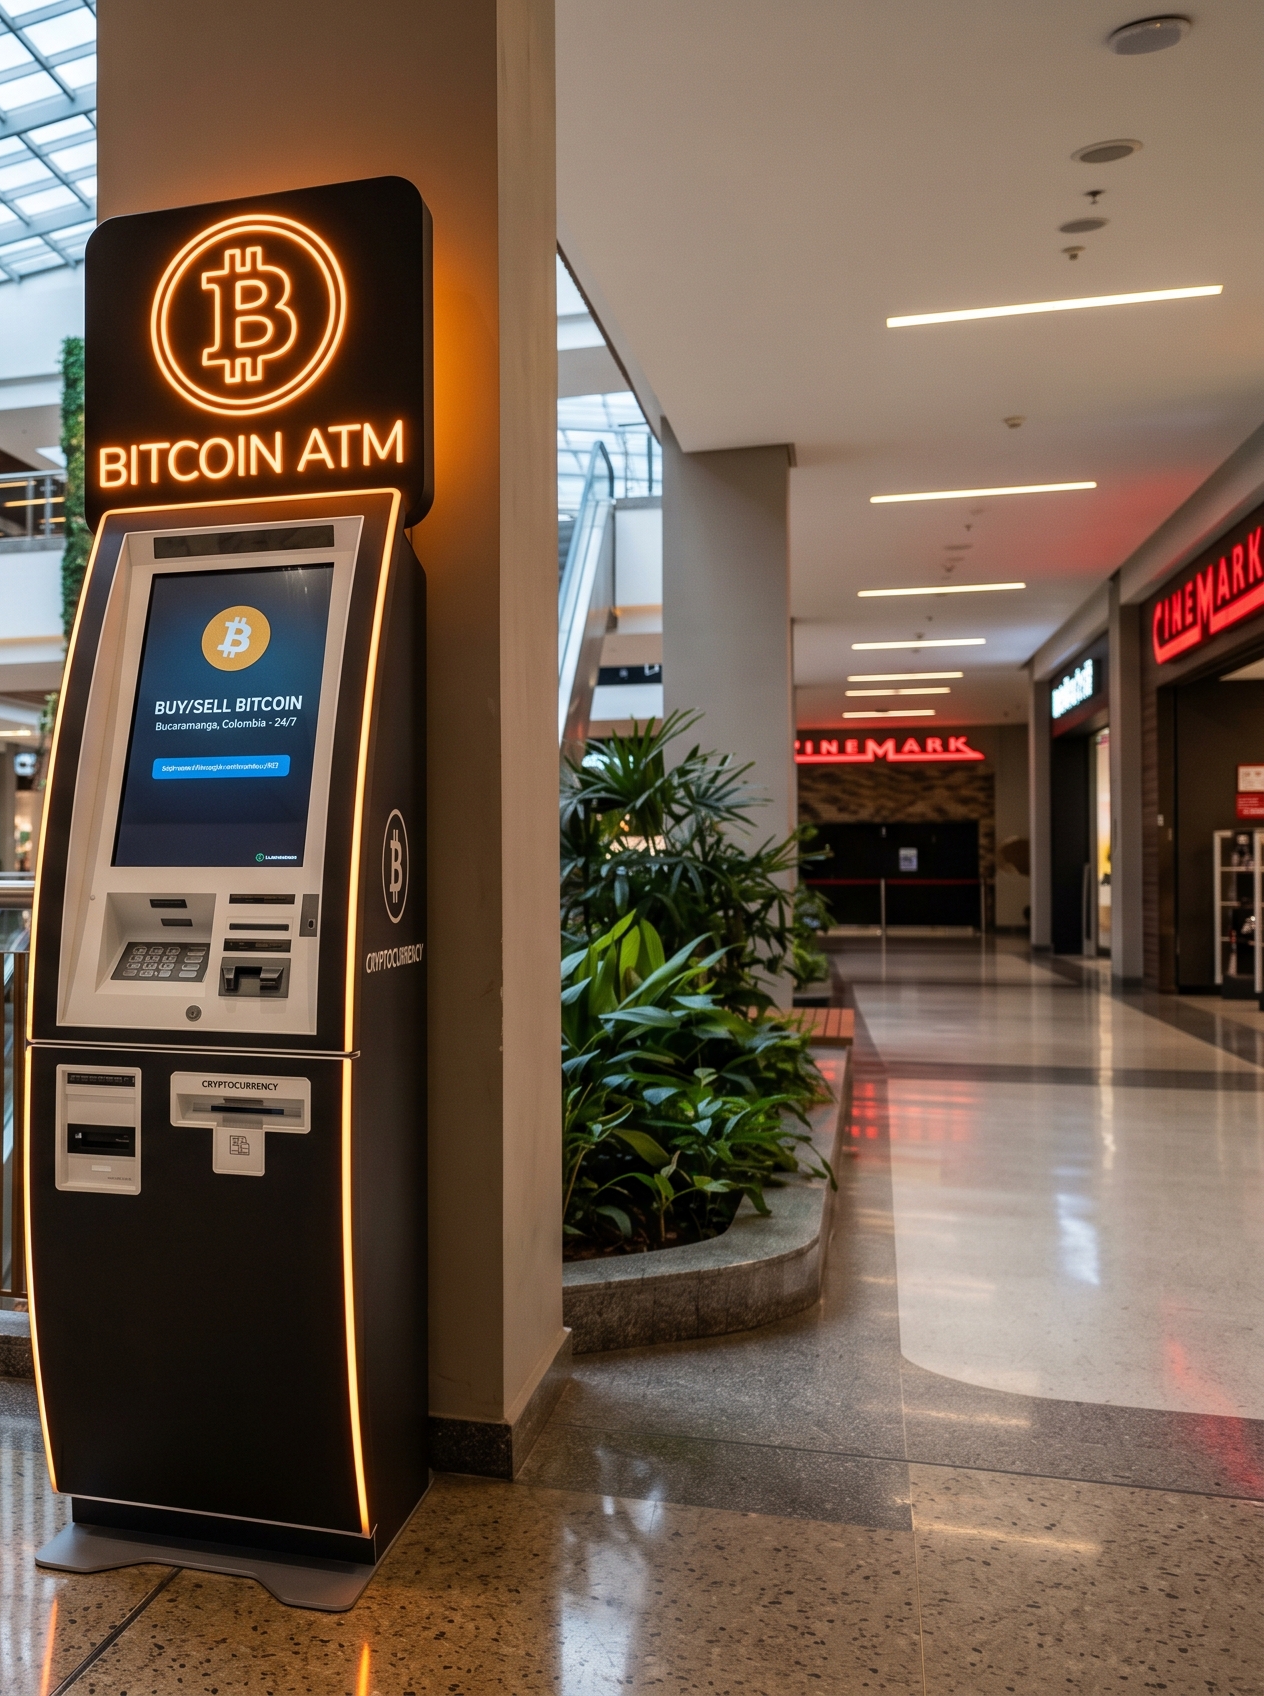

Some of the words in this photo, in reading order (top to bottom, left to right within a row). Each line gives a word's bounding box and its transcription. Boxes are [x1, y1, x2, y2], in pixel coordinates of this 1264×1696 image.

[99, 431, 283, 488] BITCOIN
[297, 420, 404, 472] ATM
[1152, 526, 1264, 665] CINEMARK
[155, 699, 232, 715] BUY/SELL
[236, 695, 303, 712] BITCOIN
[155, 720, 220, 732] Bucaramanga,
[222, 718, 266, 729] Colombia
[274, 716, 297, 728] 24/7
[201, 1080, 279, 1091] CRYPTOCURRENCY
